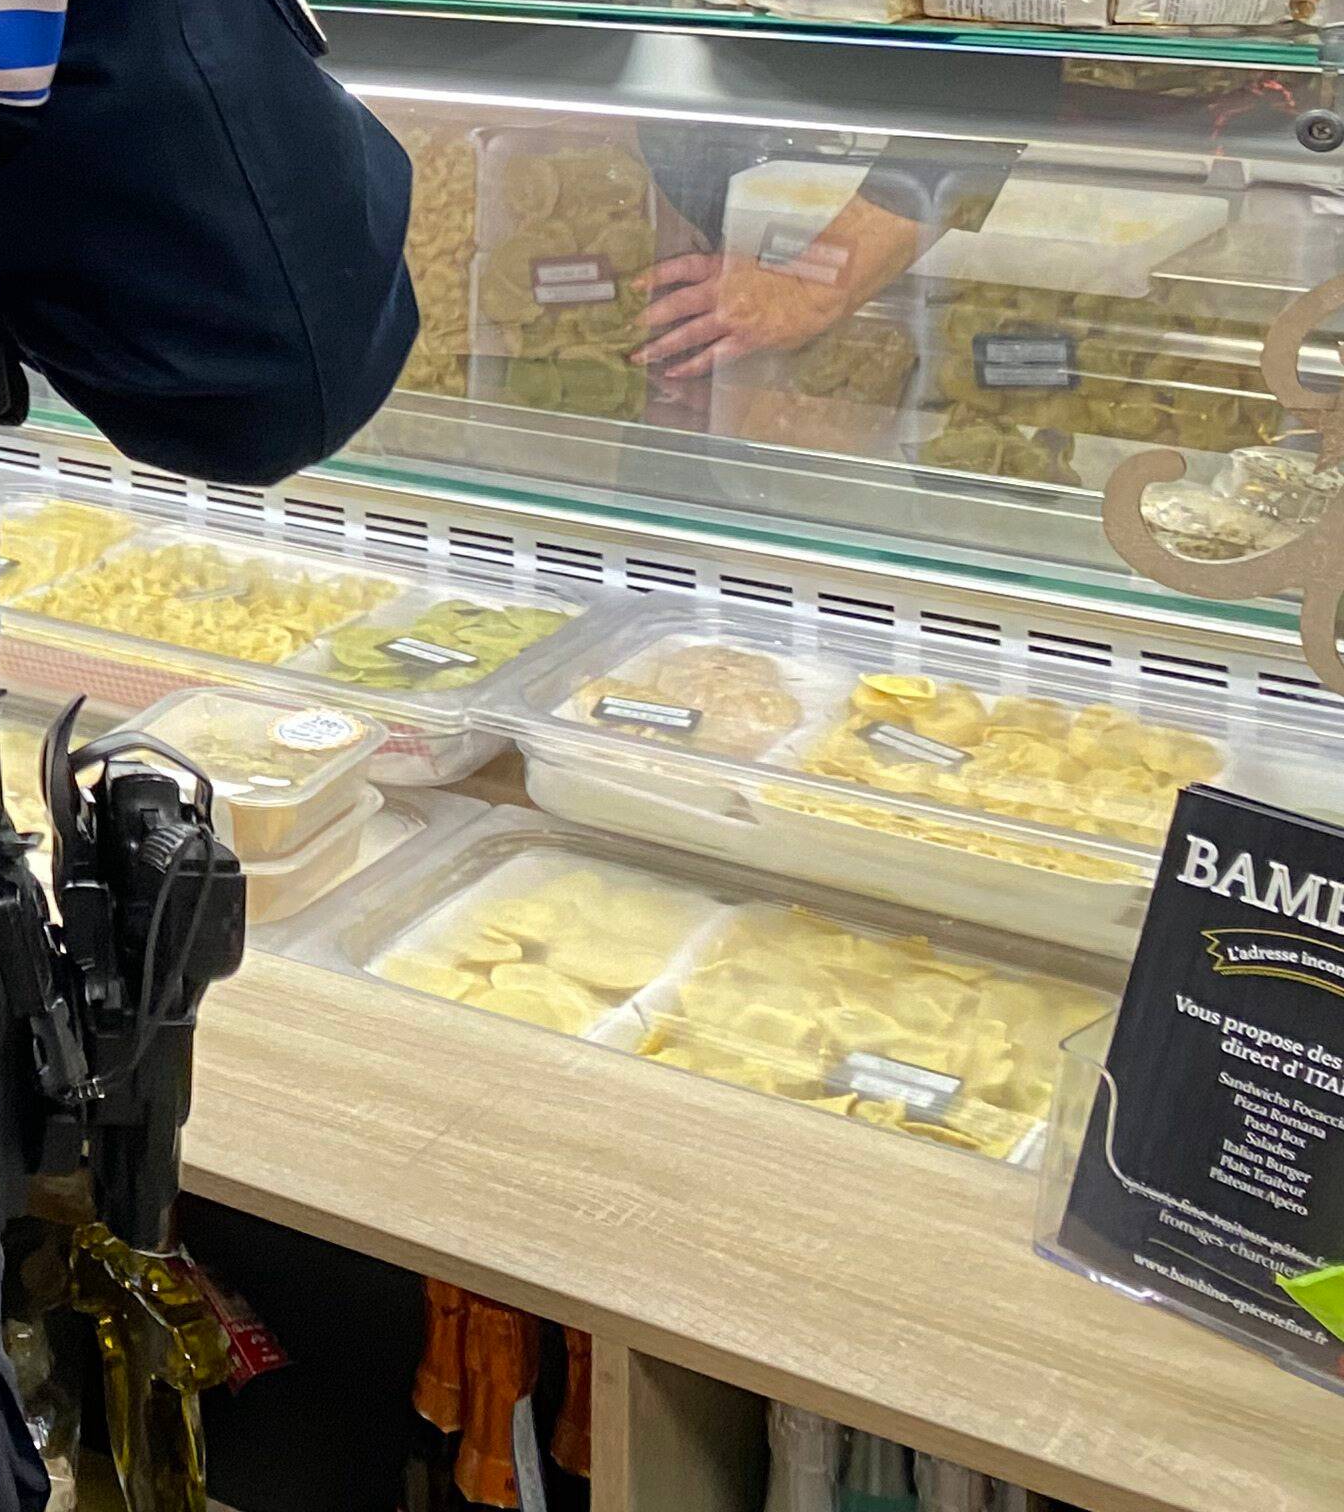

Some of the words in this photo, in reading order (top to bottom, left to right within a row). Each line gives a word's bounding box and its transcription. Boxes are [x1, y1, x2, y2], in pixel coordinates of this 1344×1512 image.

[1227, 944, 1299, 964] L'adresse
[1175, 993, 1222, 1026] Vous
[1221, 1016, 1305, 1057] propose
[1307, 1043, 1344, 1070] des
[1218, 1071, 1291, 1109] Sandwichs
[1220, 1036, 1281, 1072] direct
[1303, 1066, 1344, 1098] ITA
[1233, 1092, 1268, 1117] Pizza
[1269, 1107, 1327, 1140] Romana
[1244, 1114, 1279, 1138] Pasta
[1280, 1128, 1307, 1149] Box
[1222, 1138, 1264, 1165] Italian
[1265, 1156, 1313, 1184] Burger
[1245, 1131, 1297, 1161] Salades
[1209, 1166, 1265, 1200] Plateaux
[1265, 1190, 1309, 1217] Apéro
[1219, 1154, 1251, 1177] Plats
[1253, 1166, 1307, 1199] Traiteur
[1133, 1252, 1329, 1346] www.bambino-epiceriefine.fr
